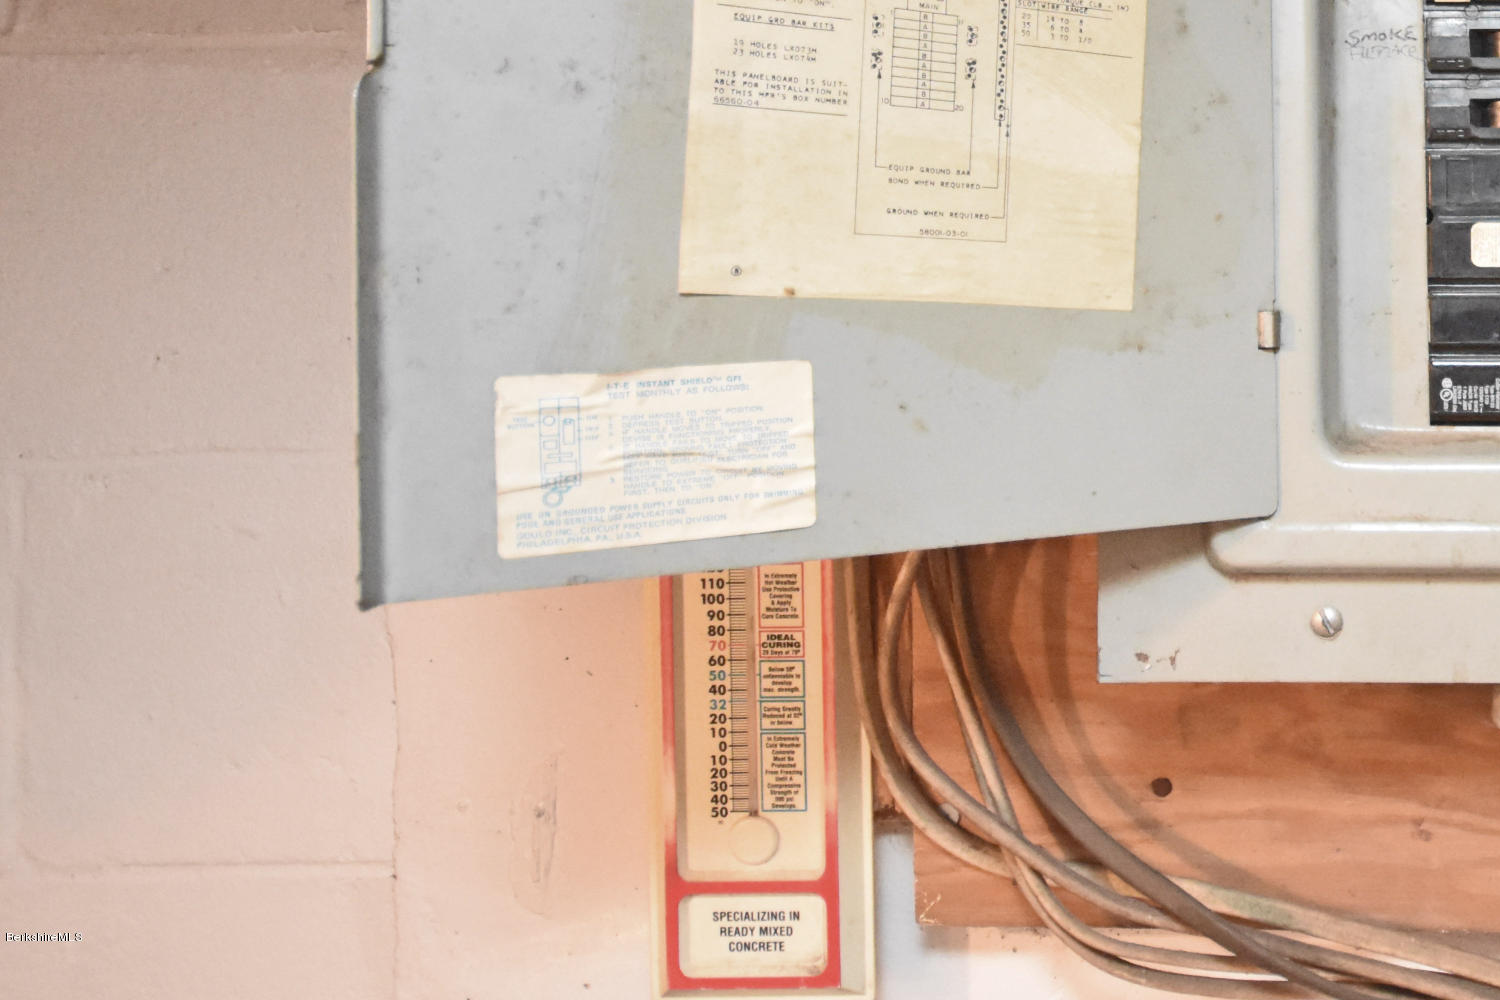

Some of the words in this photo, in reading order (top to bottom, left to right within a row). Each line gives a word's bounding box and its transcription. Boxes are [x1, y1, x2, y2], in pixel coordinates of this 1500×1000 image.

[919, 2, 939, 10] MAIN
[751, 42, 777, 50] HOLES
[750, 51, 777, 59] HOLES
[715, 69, 736, 77] THIS
[743, 73, 799, 83] PANELBOARD
[766, 84, 831, 95] INSTALLATION
[920, 167, 951, 175] GROUND
[941, 182, 981, 190] REQUIRED
[887, 208, 918, 216] GROUND
[950, 212, 989, 220] REQUIRED
[701, 579, 724, 589] 110
[701, 594, 725, 604] 100
[707, 610, 725, 620] 90
[708, 625, 725, 636] 80
[709, 640, 726, 651] 70
[709, 656, 726, 666] 60
[709, 670, 726, 680] 50
[709, 685, 726, 695] 40
[710, 700, 726, 710] 32
[710, 714, 726, 724] 20
[711, 728, 726, 738] 10
[719, 741, 727, 752] 0
[711, 755, 727, 765] 10
[711, 768, 727, 779] 20
[711, 781, 727, 792] 30
[711, 794, 728, 805] 40
[712, 807, 728, 817] 50
[713, 911, 785, 922] SPECIALIZING
[790, 911, 800, 920] IN
[720, 927, 755, 936] READY
[760, 927, 793, 936] MIXED
[729, 941, 785, 952] CONCRETE
